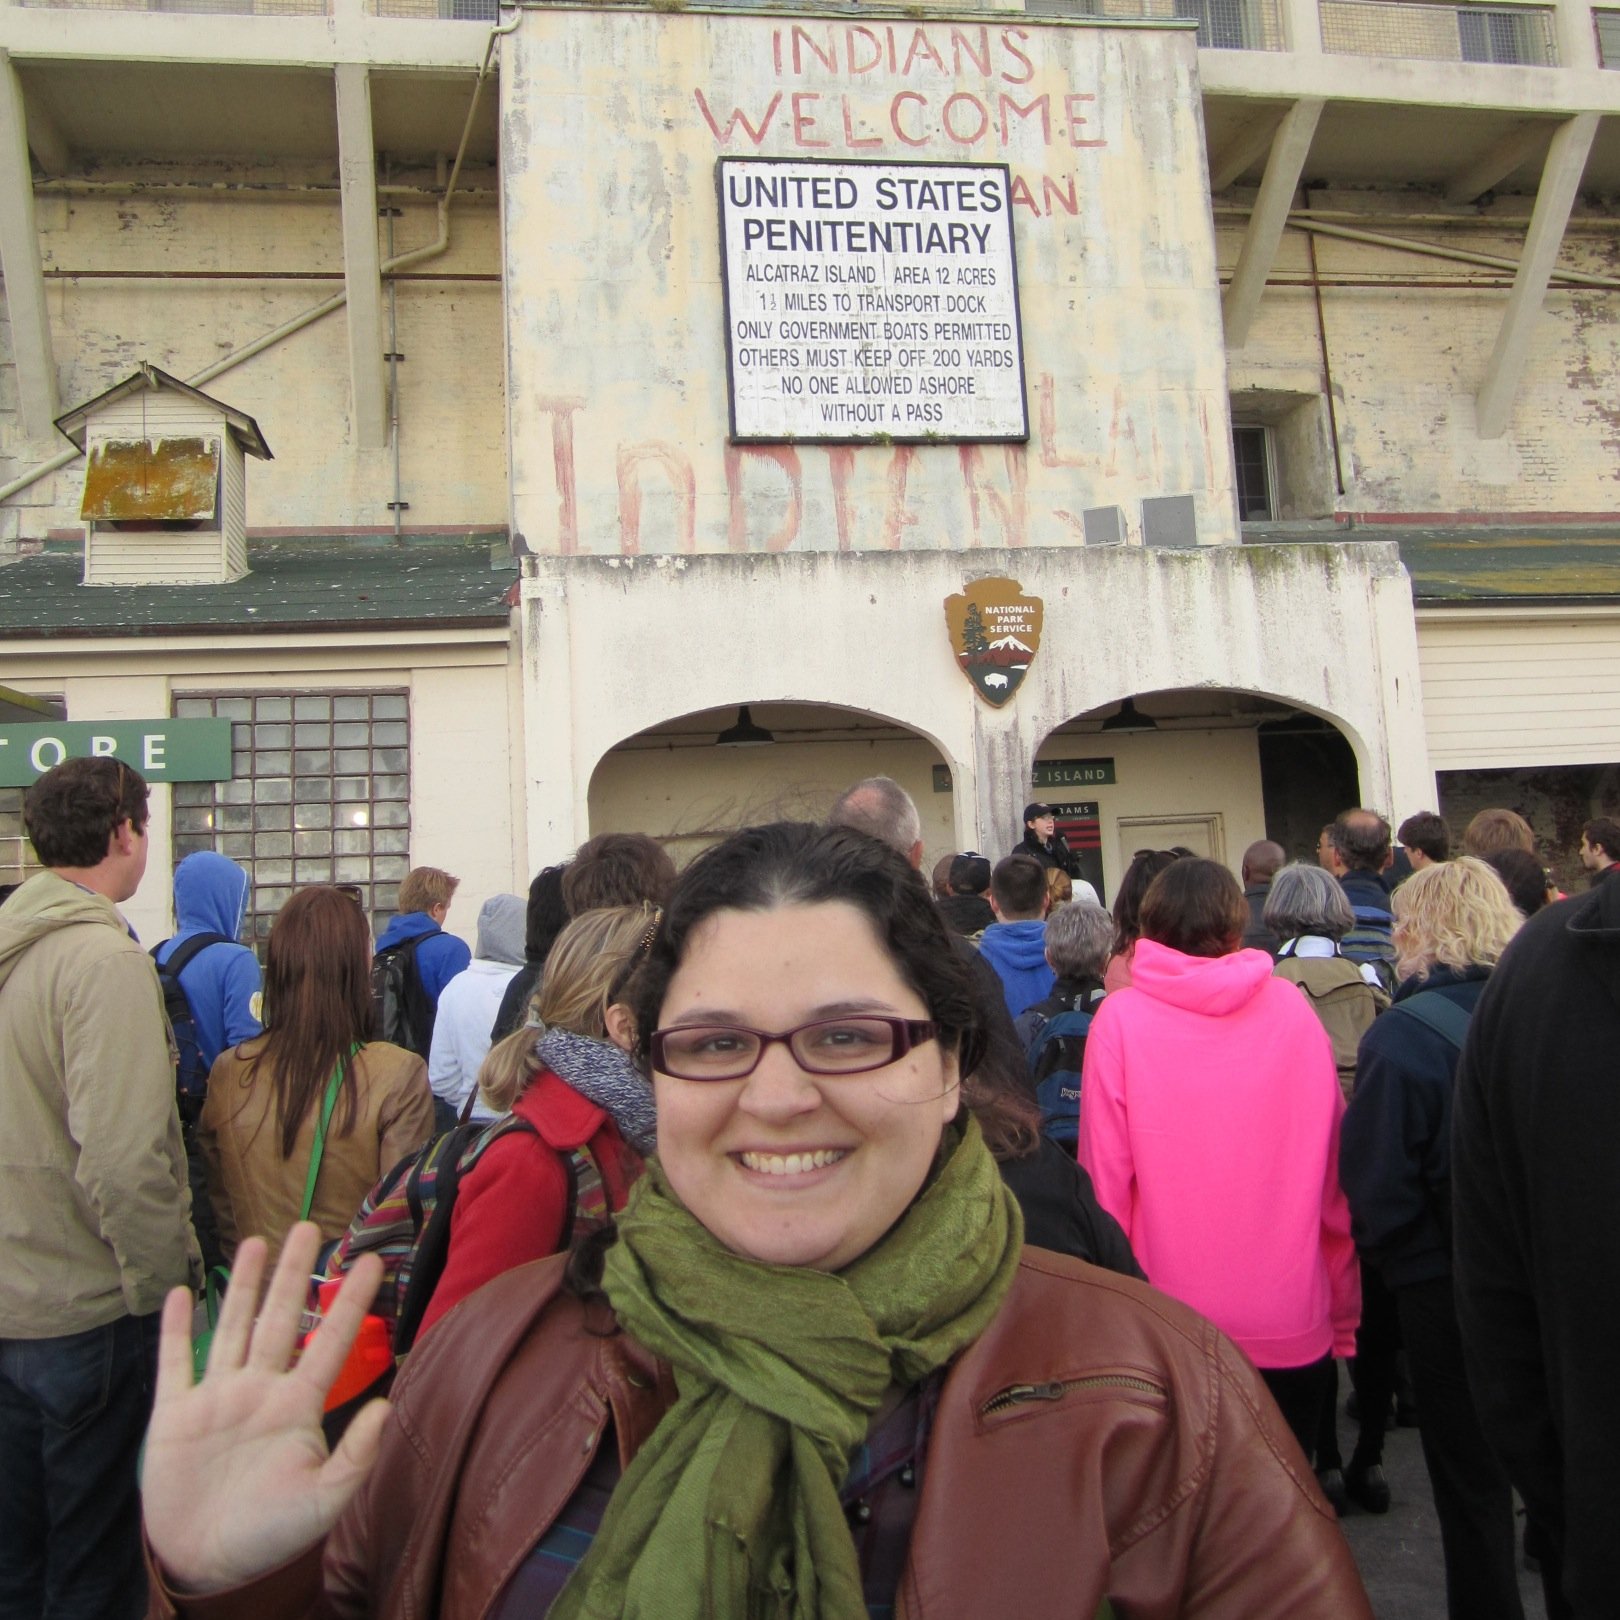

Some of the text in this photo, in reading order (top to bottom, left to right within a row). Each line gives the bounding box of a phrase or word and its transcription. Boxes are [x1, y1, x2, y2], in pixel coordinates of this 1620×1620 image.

[773, 24, 1035, 84] INDIANS
[694, 88, 1108, 149] WELCOME
[729, 175, 1002, 213] UNITED STATES
[743, 218, 992, 255] PENITENTIARY
[746, 263, 996, 286] ALCATRAZ ISLAND AREA 12 ACRES
[785, 293, 828, 312] MILES
[832, 293, 852, 312] TO
[857, 294, 940, 313] TRANSPORT
[947, 295, 987, 313] DOCK
[737, 321, 1012, 341] ONLY GOVERNMENT BOATS PERMITTED
[739, 349, 1014, 368] OTHERS MUST KEEP OFF 200 YARDS
[782, 376, 976, 396] NO ONE ALLOWED ASHORE
[821, 403, 943, 422] WITHOUT A PASS
[985, 606, 1035, 614] NATIONAL
[997, 615, 1024, 624] PARK
[990, 624, 1033, 633] SERVICE
[1048, 769, 1105, 782] ISLAND
